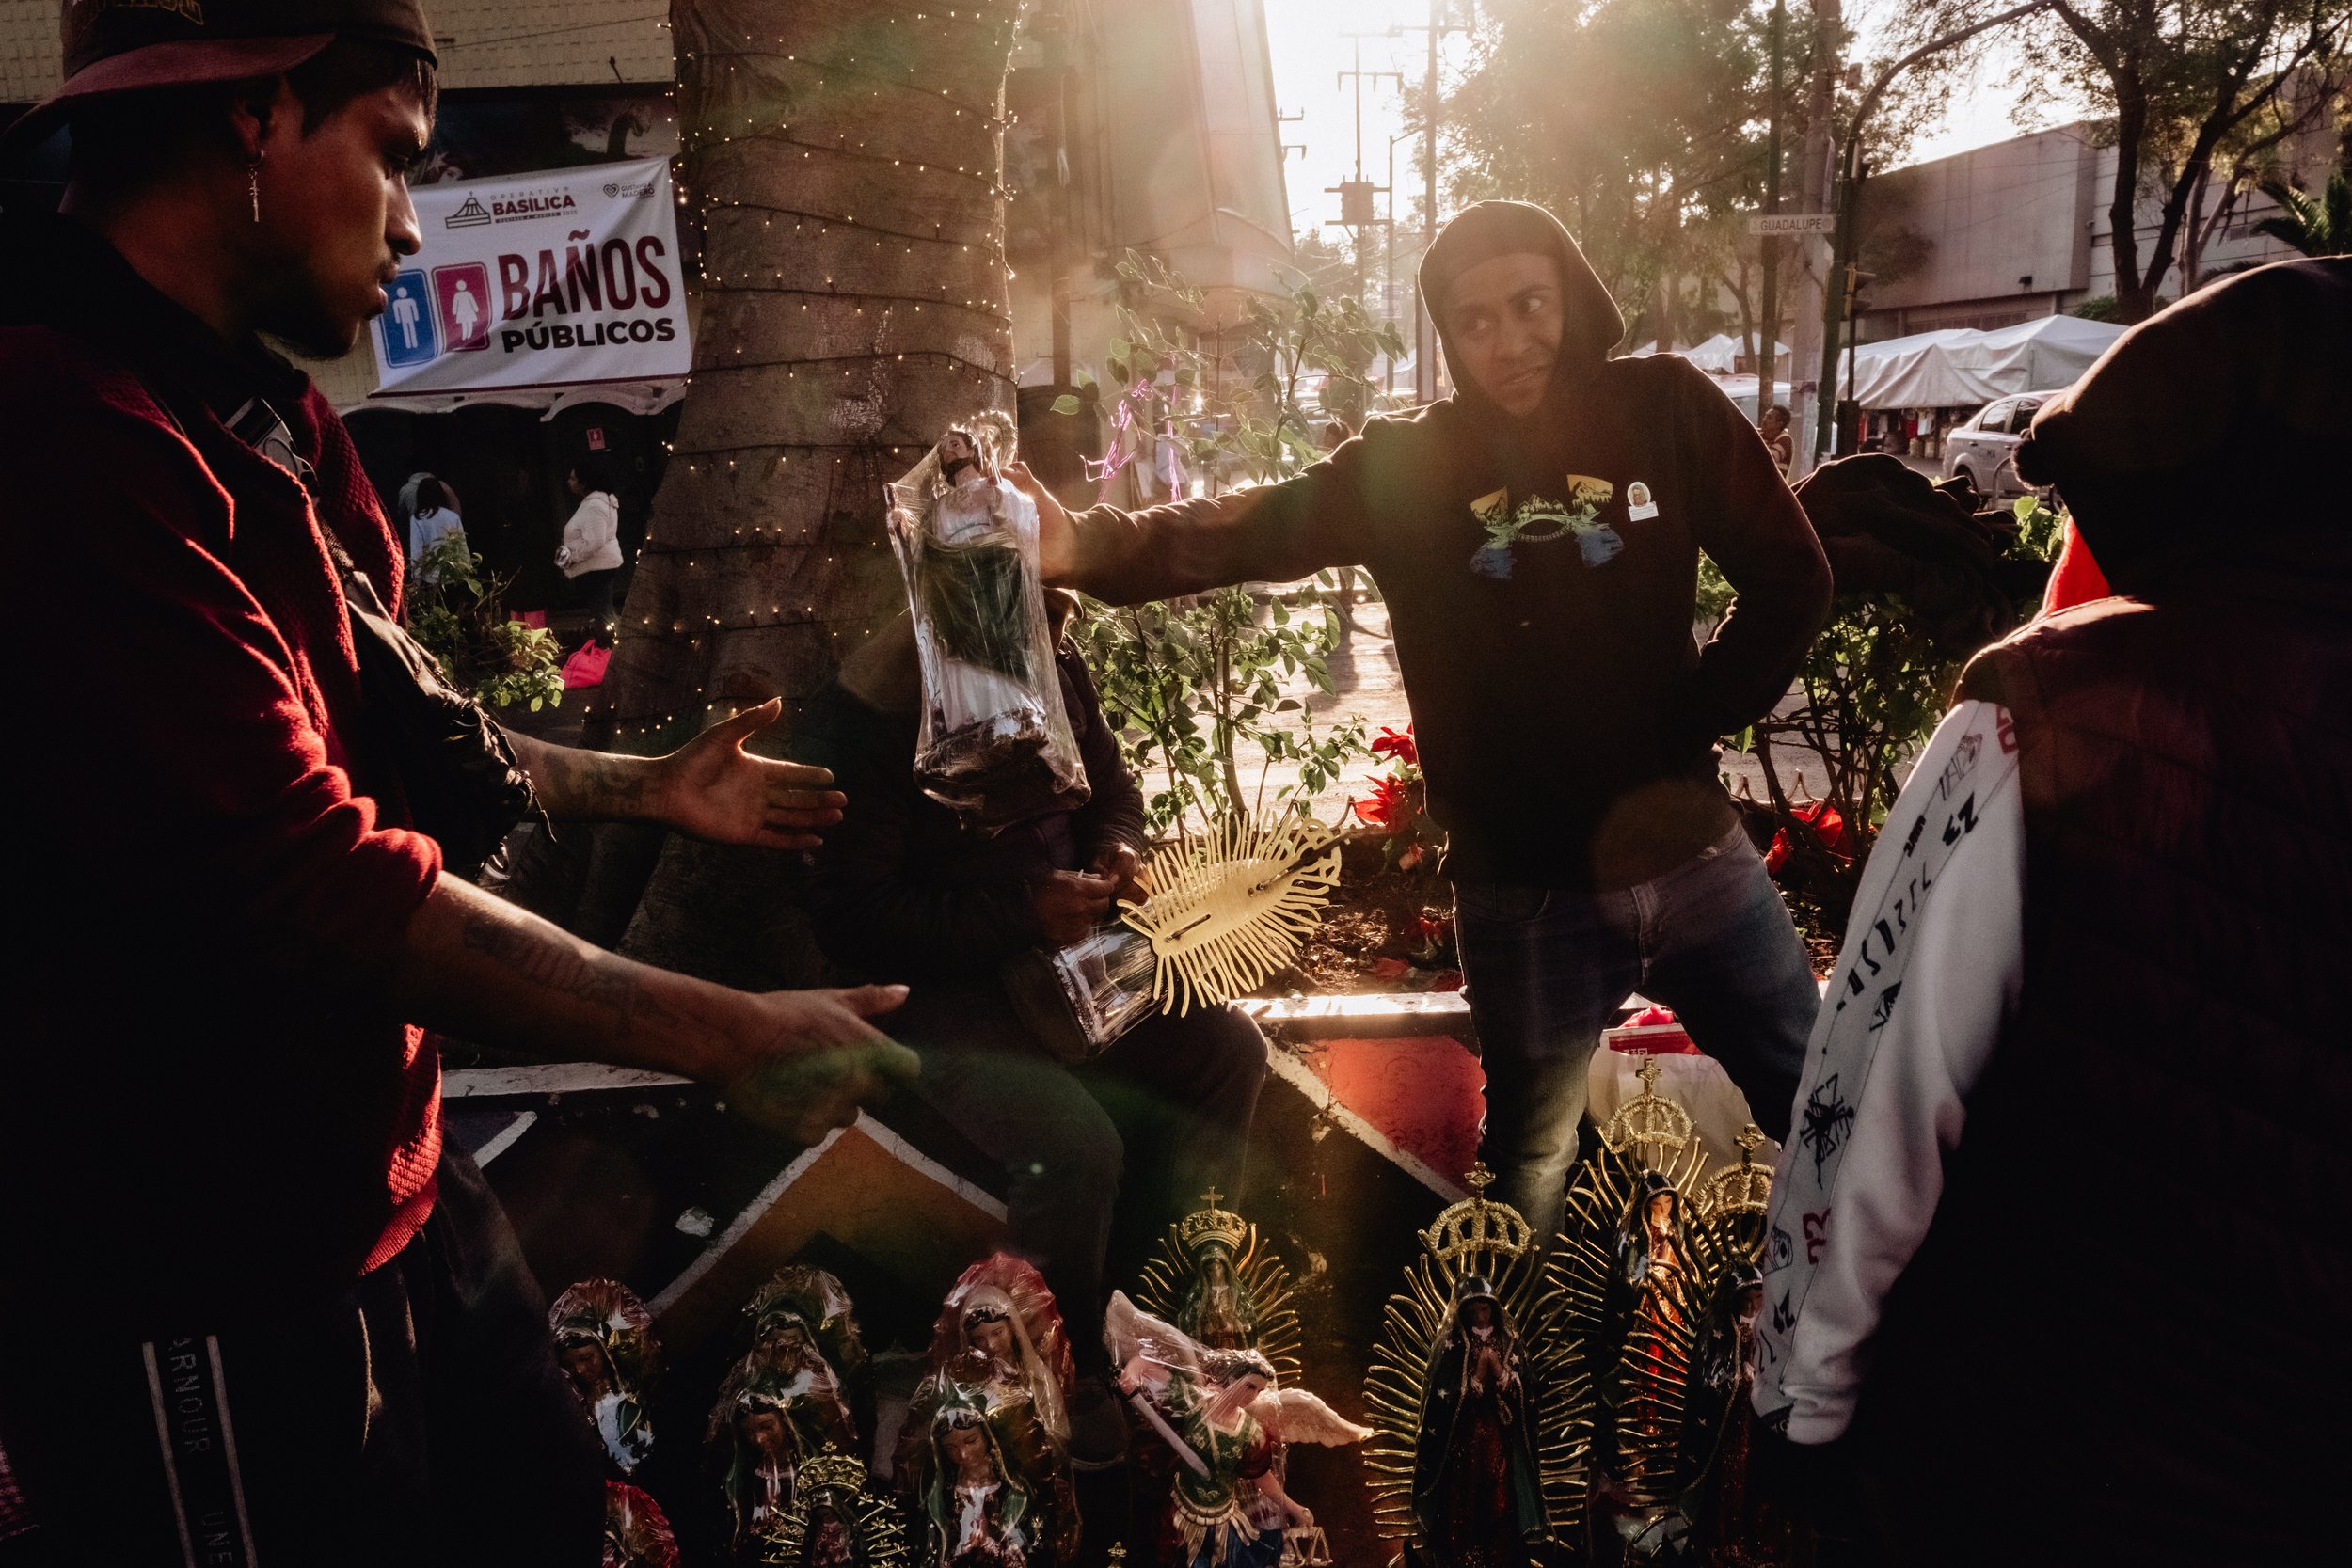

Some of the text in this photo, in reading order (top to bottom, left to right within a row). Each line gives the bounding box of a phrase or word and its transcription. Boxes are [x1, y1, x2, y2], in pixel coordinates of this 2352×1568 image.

[1760, 218, 1822, 230] GUADALUPE
[498, 229, 671, 321] BAÑOS
[501, 317, 675, 353] PÚBLICOS
